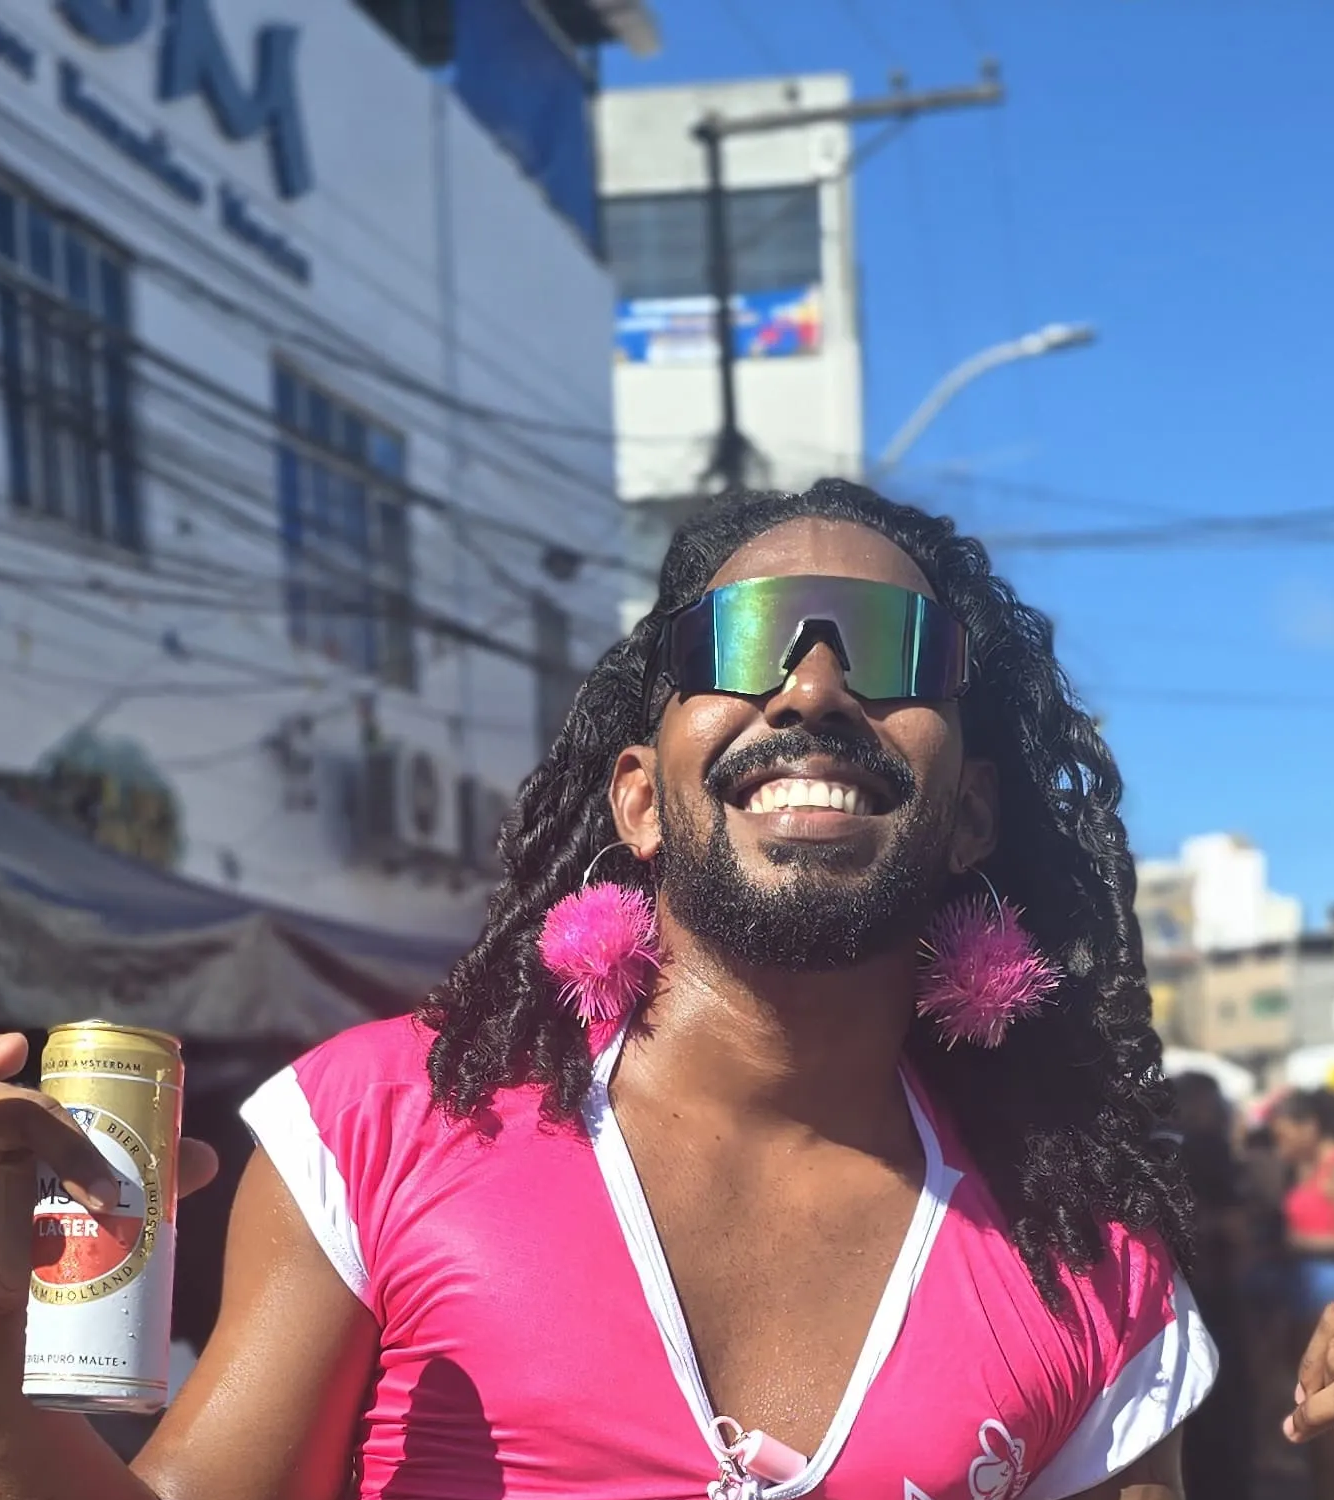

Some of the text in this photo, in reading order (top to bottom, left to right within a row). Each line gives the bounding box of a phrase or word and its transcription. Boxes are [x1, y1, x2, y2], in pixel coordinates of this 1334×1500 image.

[72, 1058, 142, 1072] AMSTERDAM
[106, 1122, 141, 1156] BIER
[37, 1218, 100, 1238] LAGER
[54, 1265, 133, 1302] HOLLAND
[47, 1354, 75, 1364] PURO
[78, 1355, 119, 1367] MALTE
